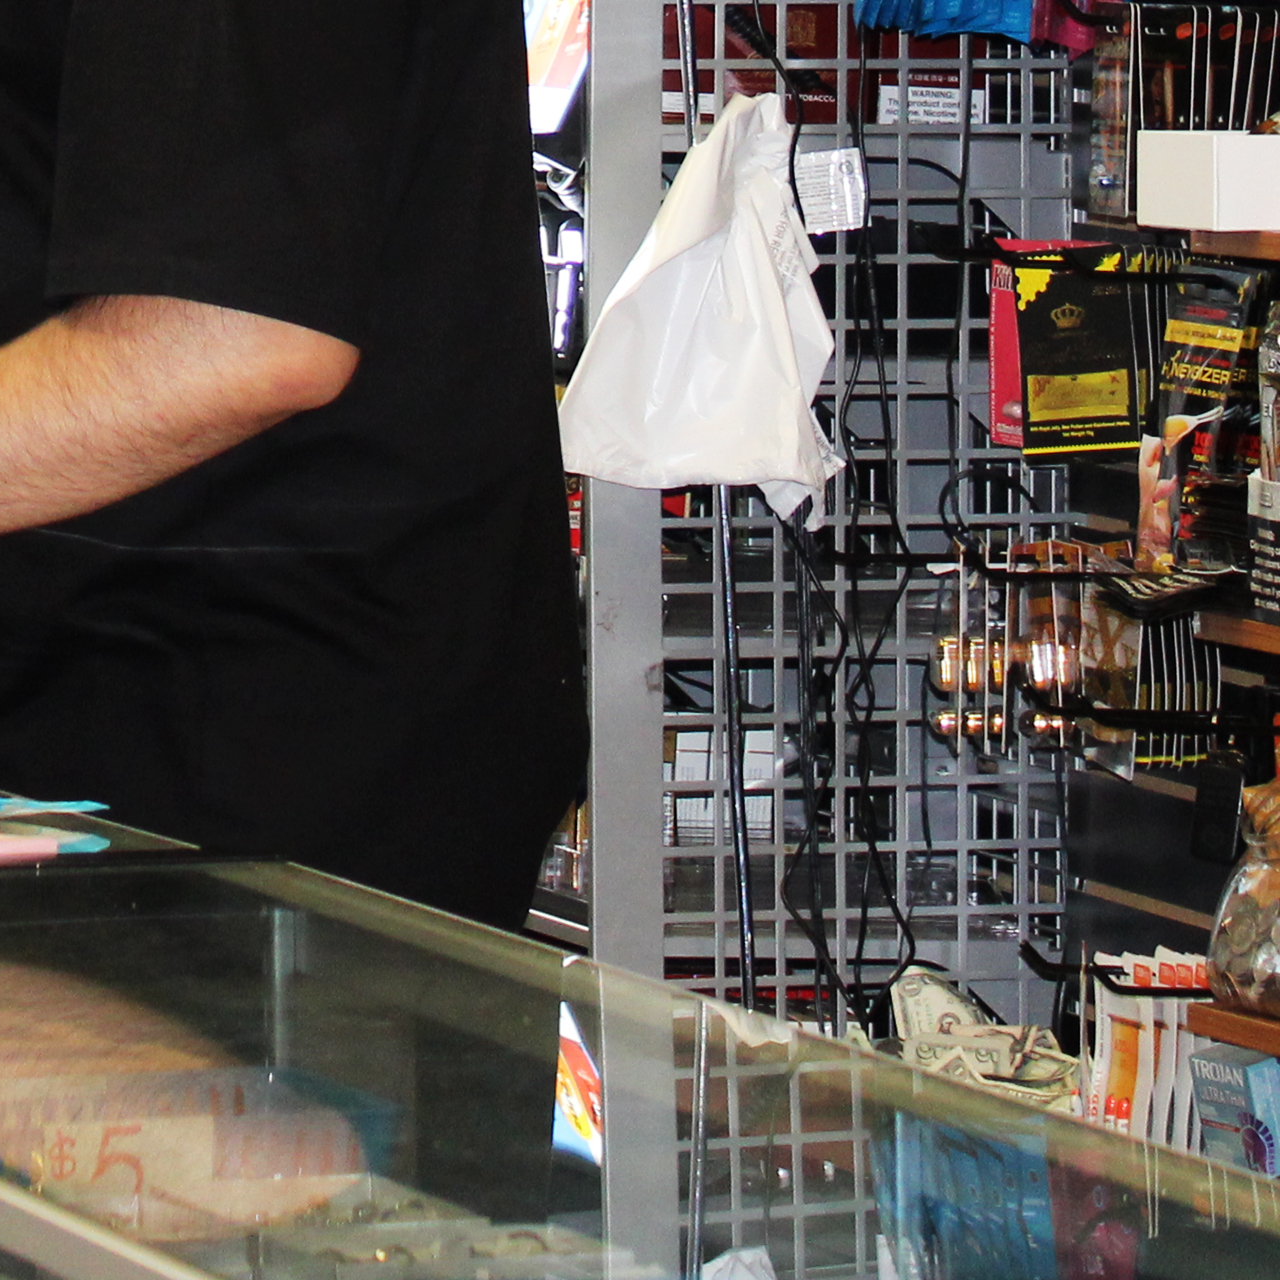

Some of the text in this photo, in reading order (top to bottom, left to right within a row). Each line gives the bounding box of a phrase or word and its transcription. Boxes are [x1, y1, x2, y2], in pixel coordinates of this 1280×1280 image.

[911, 90, 955, 99] WARNING:
[907, 99, 940, 108] product
[942, 99, 978, 108] conts
[885, 106, 957, 118] nicne. Nicotine
[774, 220, 788, 240] FOR
[1191, 1058, 1244, 1088] TROJAN
